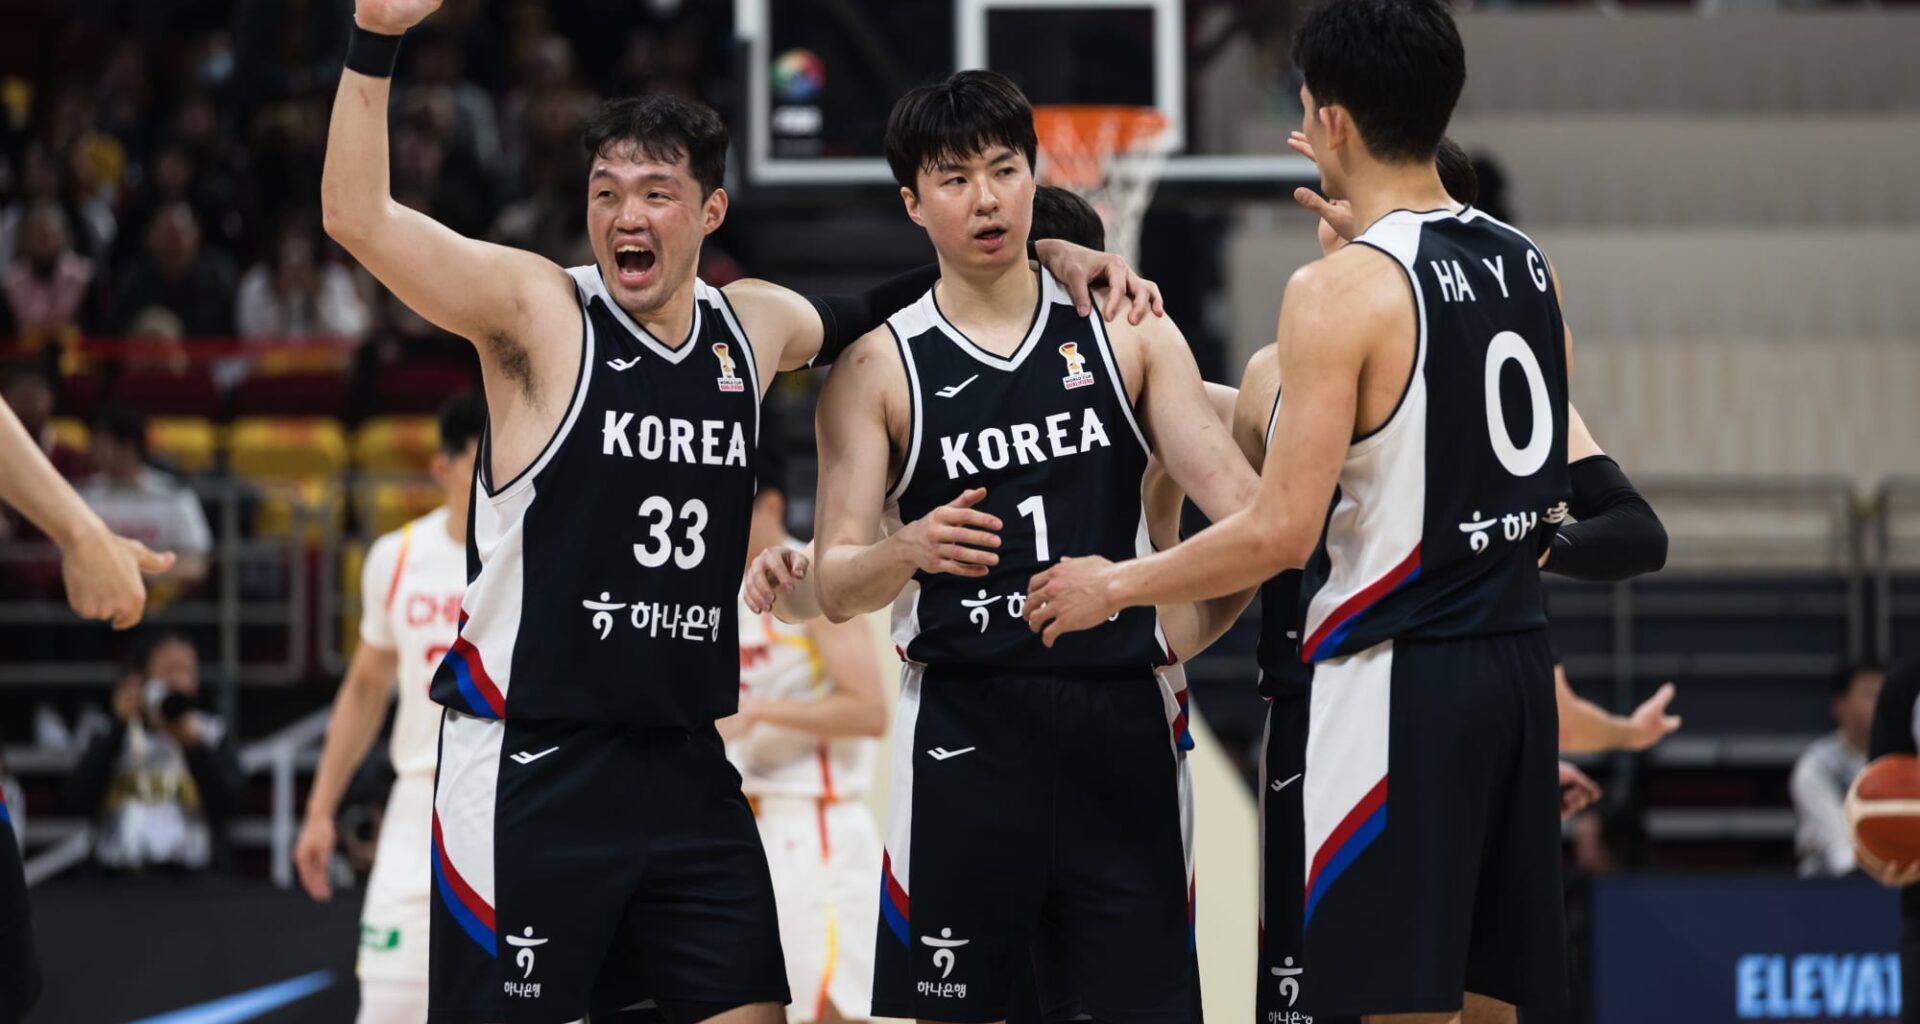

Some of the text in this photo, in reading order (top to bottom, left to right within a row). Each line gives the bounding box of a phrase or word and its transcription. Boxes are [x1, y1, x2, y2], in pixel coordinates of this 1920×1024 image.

[1430, 249, 1547, 302] HA Y G
[1485, 331, 1553, 476] 0
[602, 410, 747, 467] KOREA
[940, 407, 1111, 479] KOREA
[633, 496, 708, 570] 33
[1016, 495, 1050, 562] 1
[630, 601, 722, 643] 하나은행
[504, 981, 541, 998] 하나은행
[916, 980, 967, 999] 하나은행
